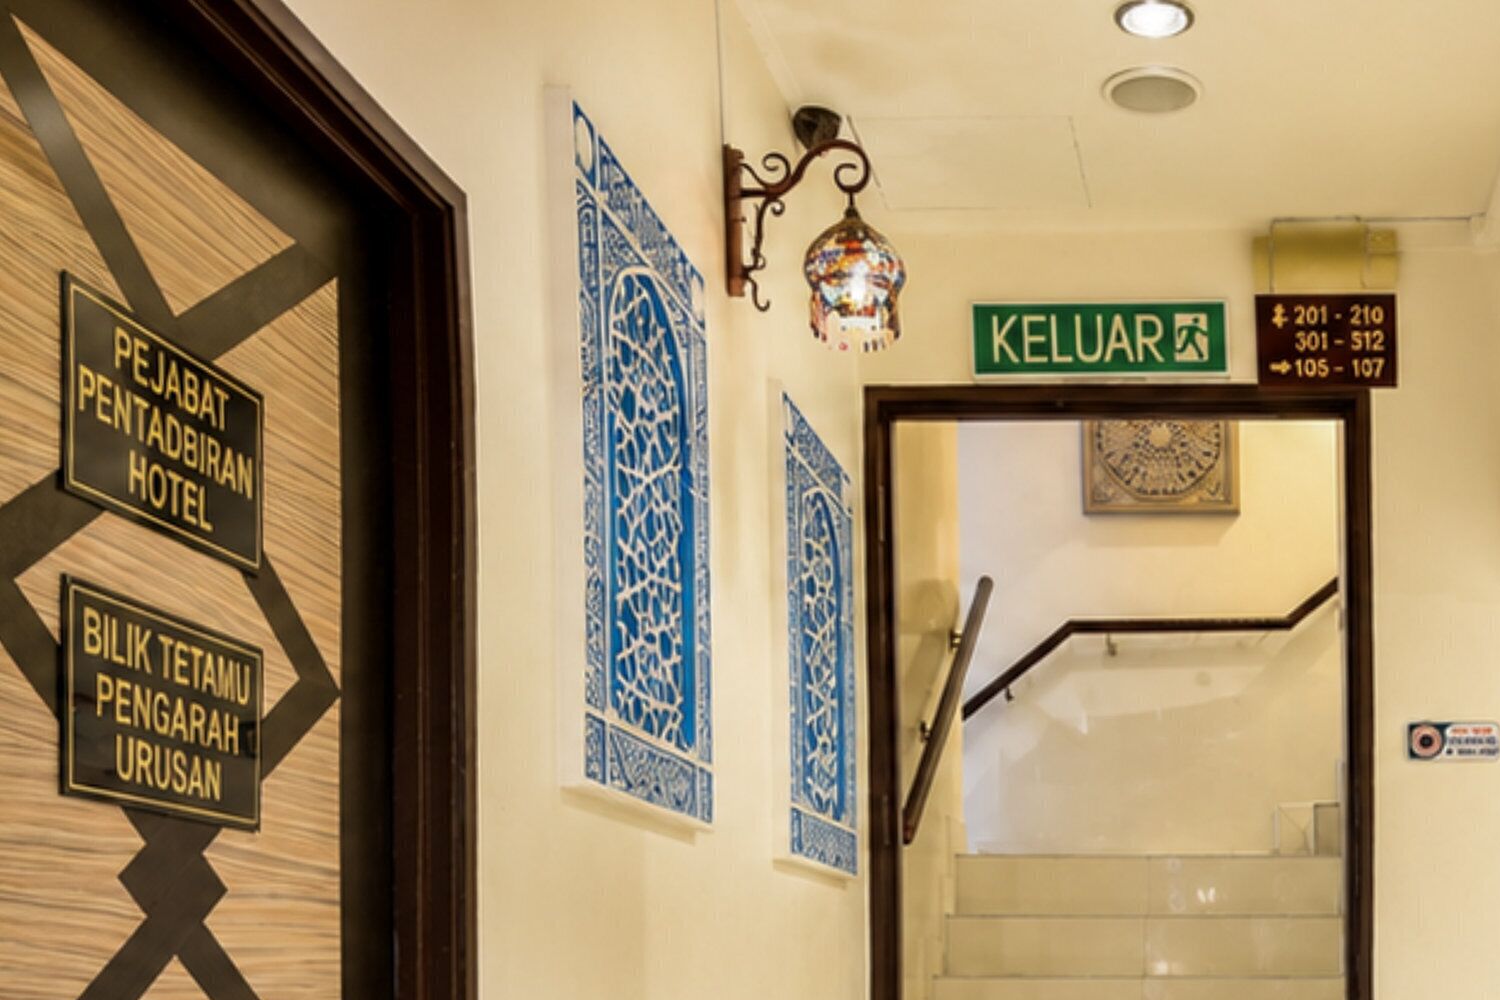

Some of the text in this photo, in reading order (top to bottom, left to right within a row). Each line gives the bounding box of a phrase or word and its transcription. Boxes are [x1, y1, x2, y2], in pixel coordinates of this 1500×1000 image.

[992, 313, 1165, 363] KELUAR
[1294, 304, 1328, 326] 201
[1350, 303, 1384, 326] 210
[1295, 330, 1328, 352] 301
[114, 325, 230, 431] PEJABAT
[1295, 357, 1329, 378] 105
[1352, 357, 1385, 378] 107
[79, 363, 254, 500] PENTADBIRAN
[129, 450, 214, 533] HOTEL
[84, 606, 251, 706] BILIK TETAMU
[97, 671, 240, 756] PENGARAH
[116, 733, 222, 801] URUSAN
